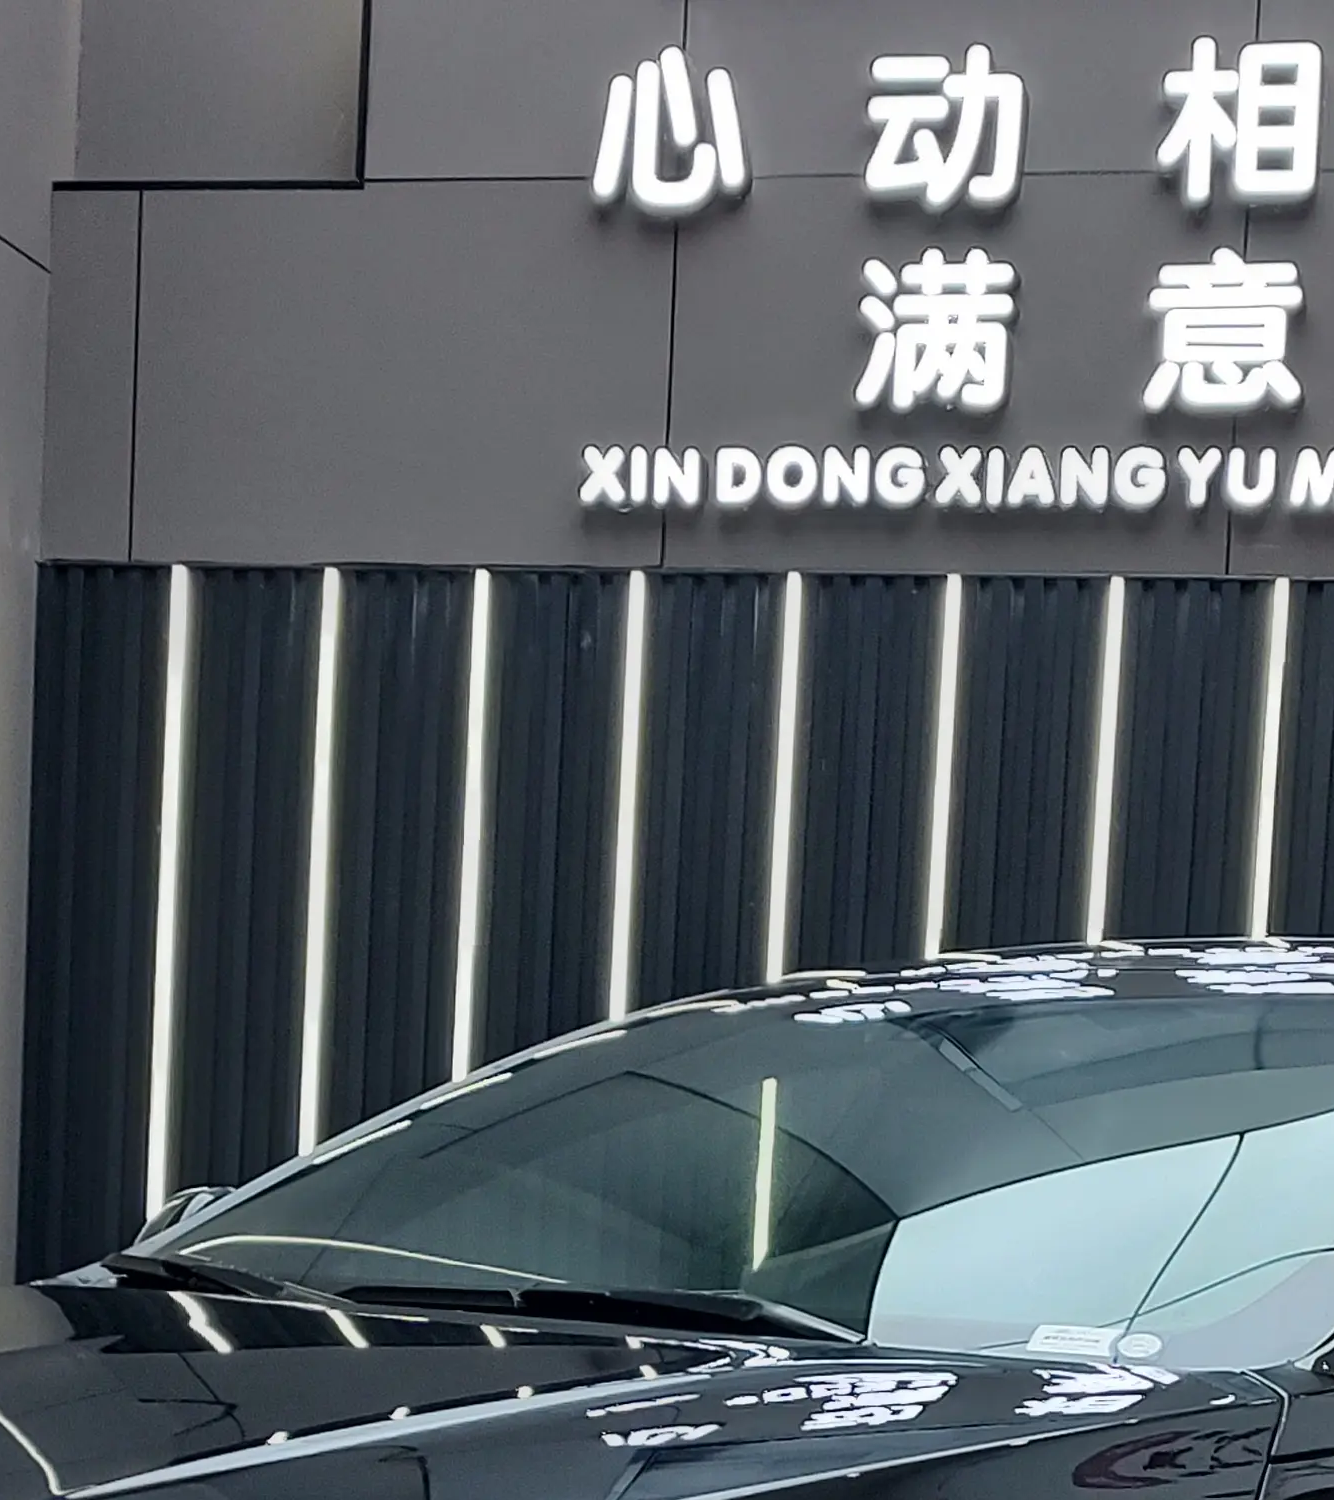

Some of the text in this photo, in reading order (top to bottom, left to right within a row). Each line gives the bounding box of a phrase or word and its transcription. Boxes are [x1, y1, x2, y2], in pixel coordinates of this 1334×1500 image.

[579, 445, 701, 505] XIN
[715, 445, 926, 505] DONG
[934, 445, 1167, 506] XIANG
[1177, 446, 1277, 507] YU
